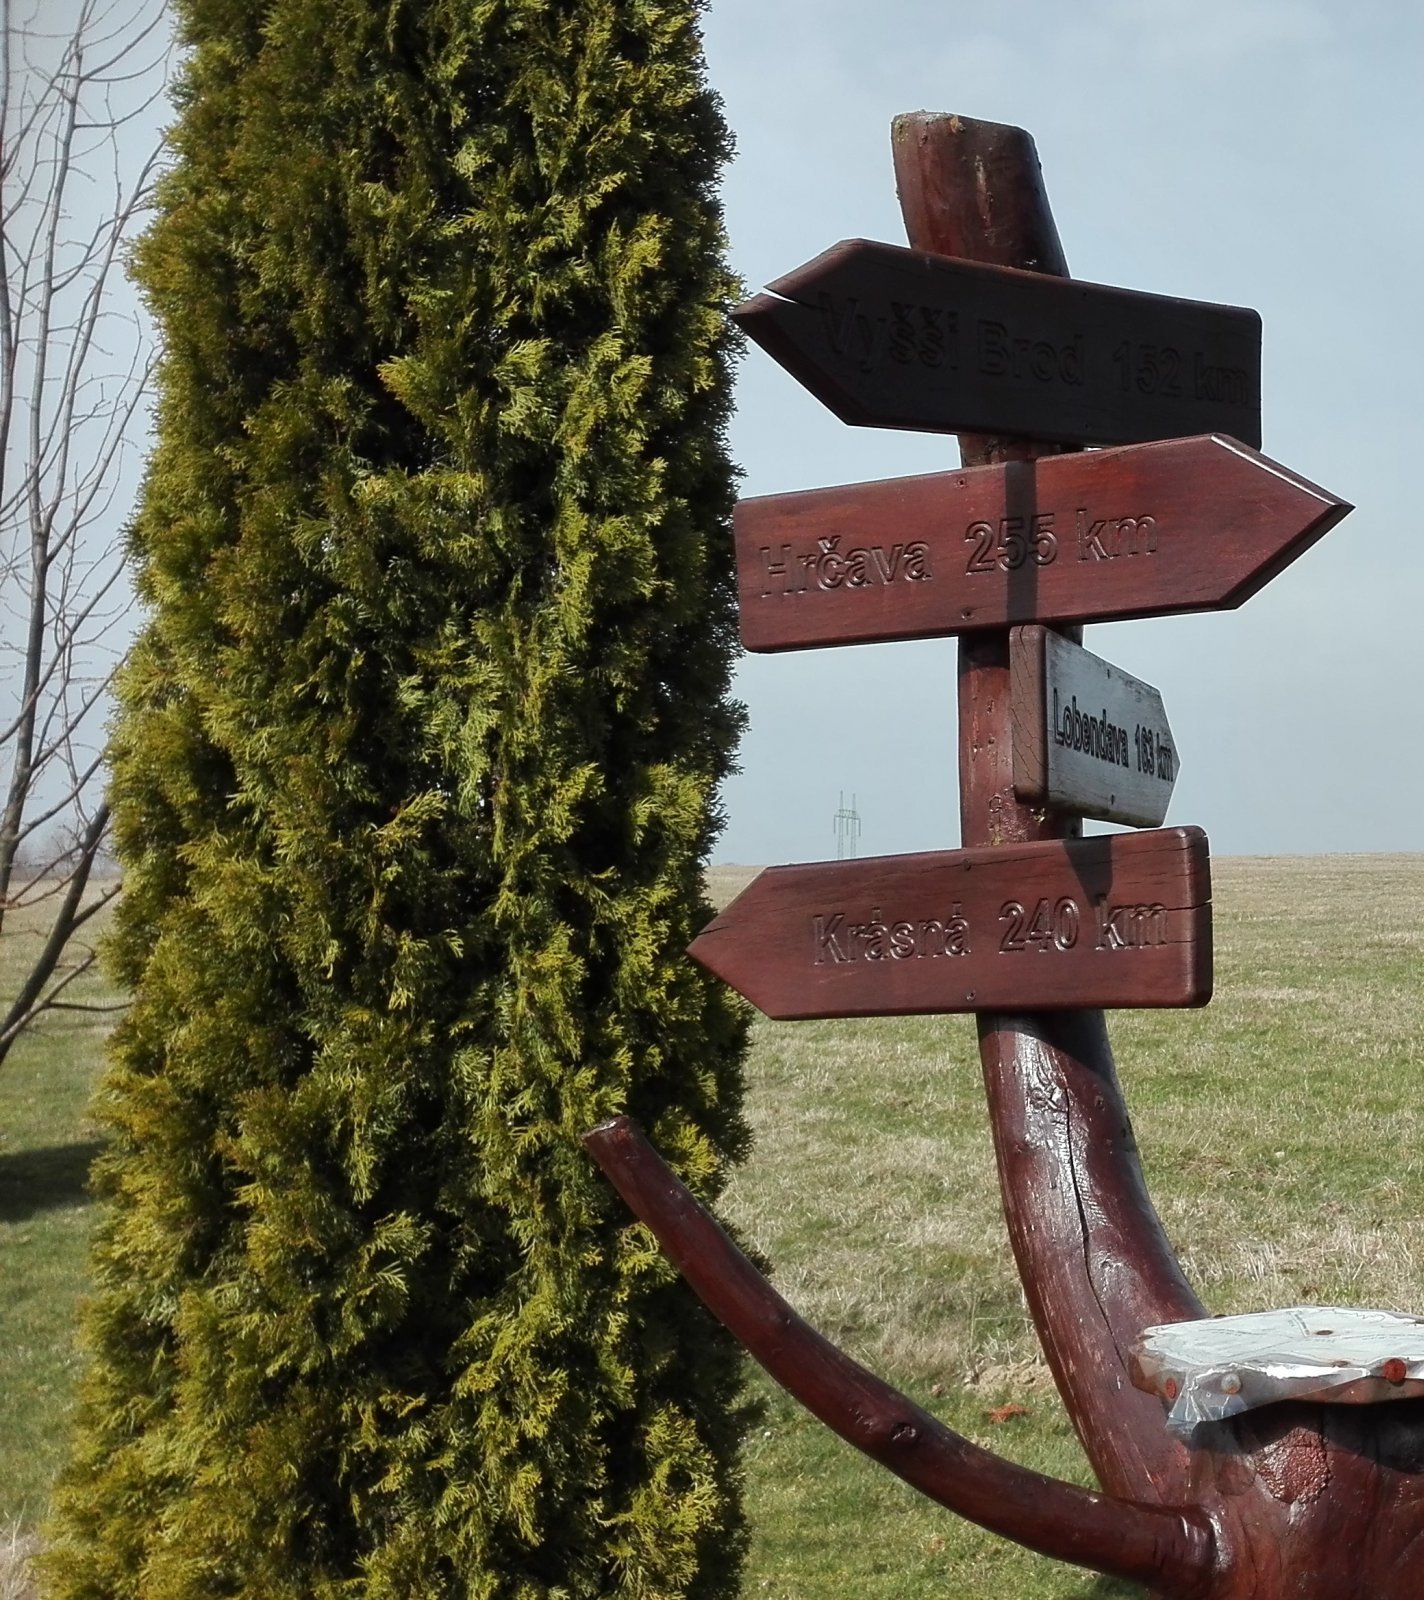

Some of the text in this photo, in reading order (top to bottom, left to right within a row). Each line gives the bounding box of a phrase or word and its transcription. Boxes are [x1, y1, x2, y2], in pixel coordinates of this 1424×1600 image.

[975, 318, 1086, 387] Brod
[1112, 339, 1185, 399] 152
[1193, 351, 1250, 406] km
[759, 508, 1158, 599] Hrčava 255 km
[1053, 687, 1130, 769] Lobendava
[1156, 732, 1174, 783] km
[812, 894, 1169, 966] Krásná 240 km
